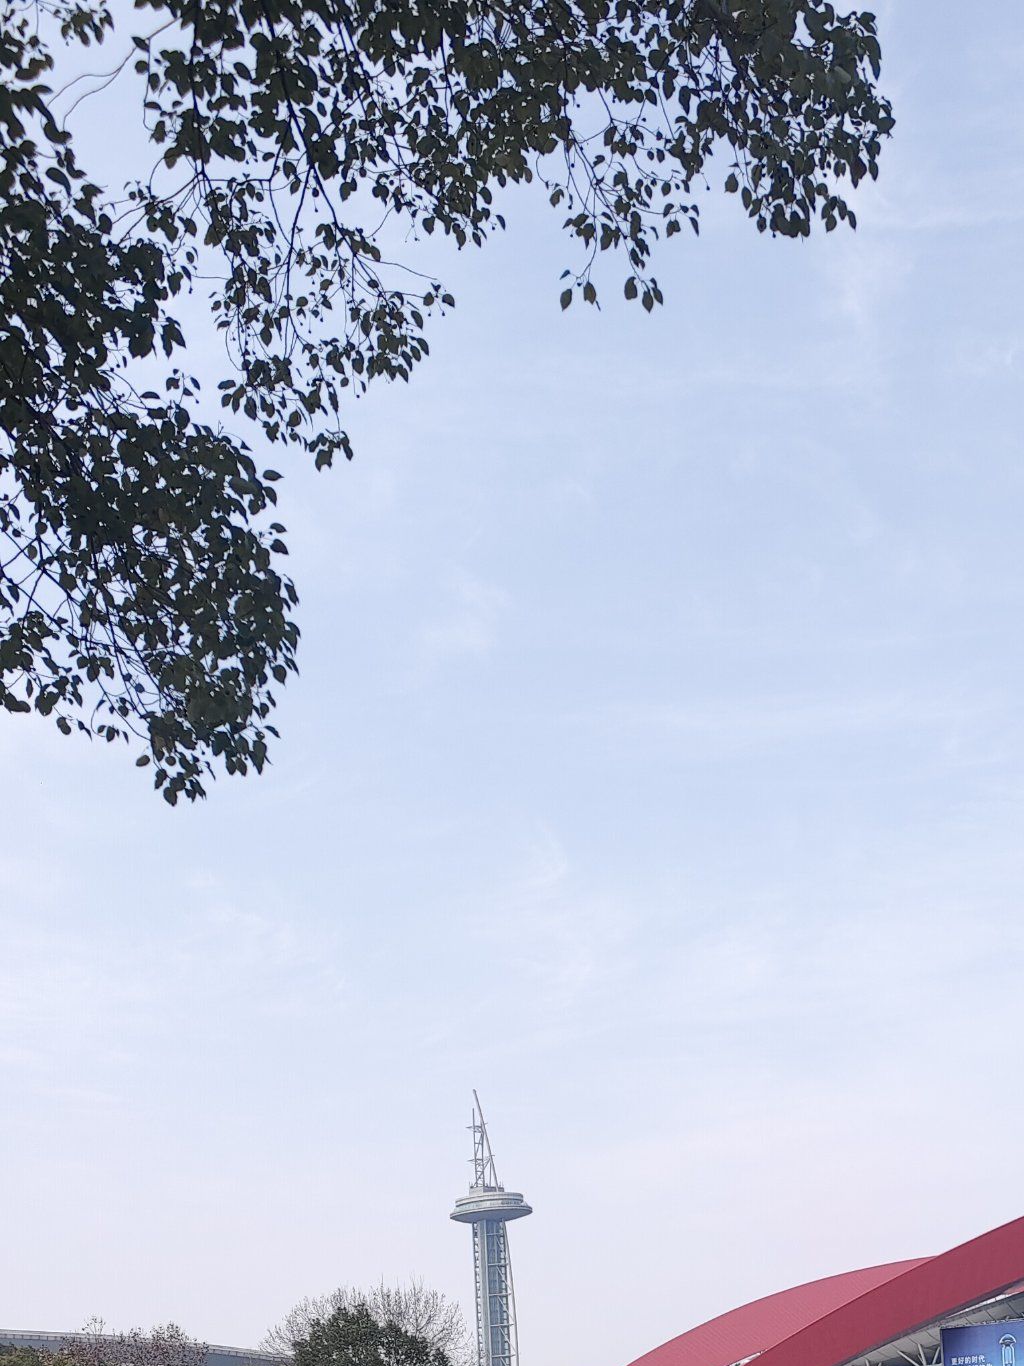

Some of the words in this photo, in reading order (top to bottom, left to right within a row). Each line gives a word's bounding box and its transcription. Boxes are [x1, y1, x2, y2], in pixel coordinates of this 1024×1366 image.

[951, 1355, 985, 1365] 更好的时代
